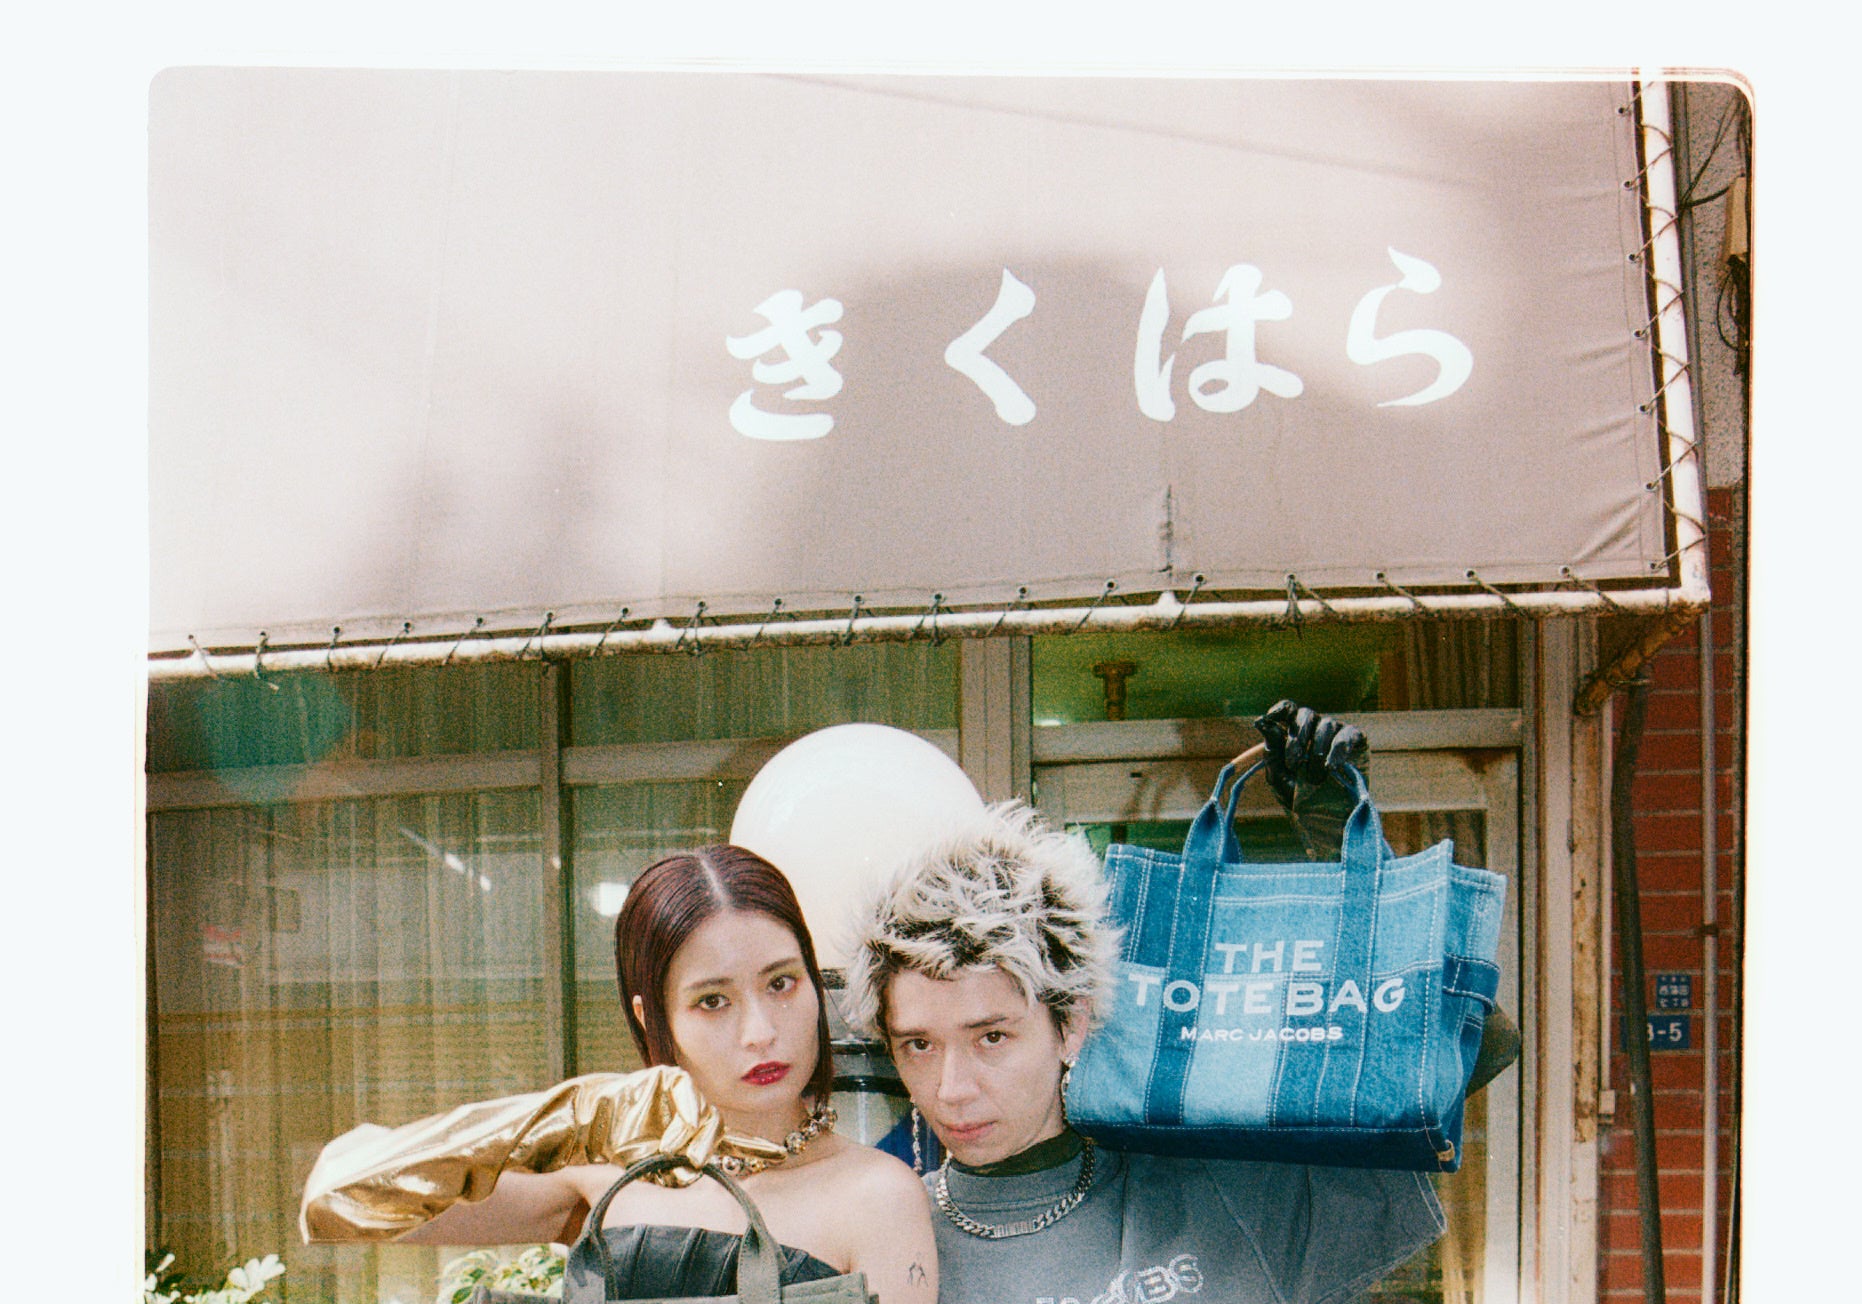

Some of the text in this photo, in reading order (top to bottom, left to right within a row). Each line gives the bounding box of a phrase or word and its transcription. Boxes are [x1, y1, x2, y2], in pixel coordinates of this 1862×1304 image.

[726, 246, 1474, 441] きくはら
[1214, 939, 1325, 974] THE
[1128, 973, 1406, 1016] TOTE BAG
[1180, 1026, 1344, 1042] MARC JACOBS
